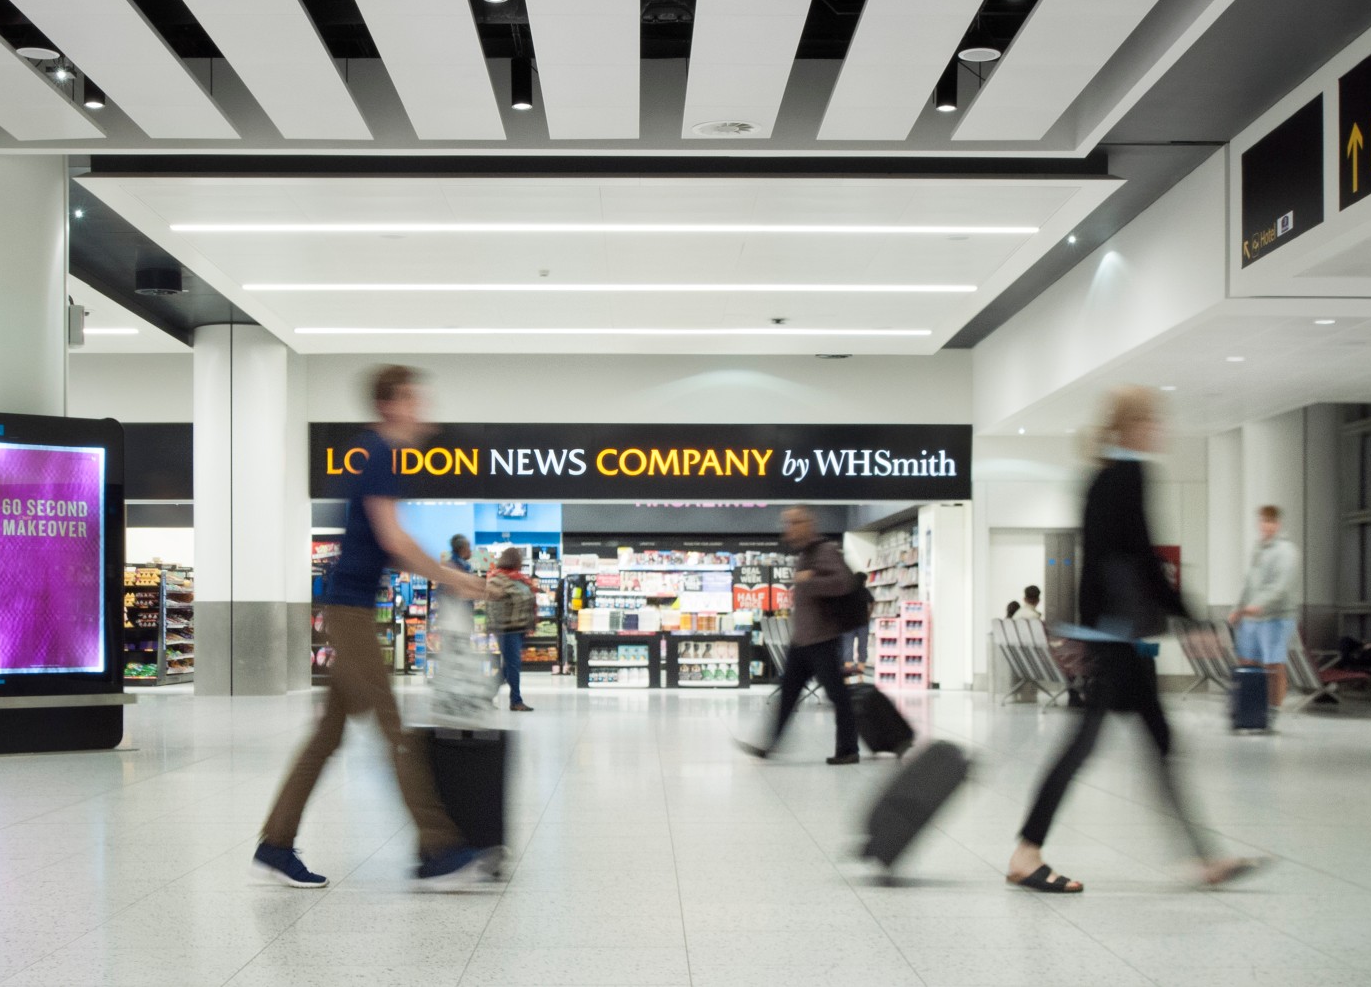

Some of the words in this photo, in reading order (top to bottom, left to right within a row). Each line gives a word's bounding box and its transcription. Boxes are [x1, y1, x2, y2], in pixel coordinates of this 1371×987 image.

[1260, 222, 1276, 248] Hotel
[326, 447, 479, 475] LODON
[490, 448, 587, 476] NEWS
[596, 448, 773, 476] COMPANY
[782, 449, 810, 482] by
[814, 449, 957, 476] WHSmith
[2, 498, 21, 515] 60
[27, 499, 88, 517] SECOND
[2, 519, 87, 537] MAKEOVER
